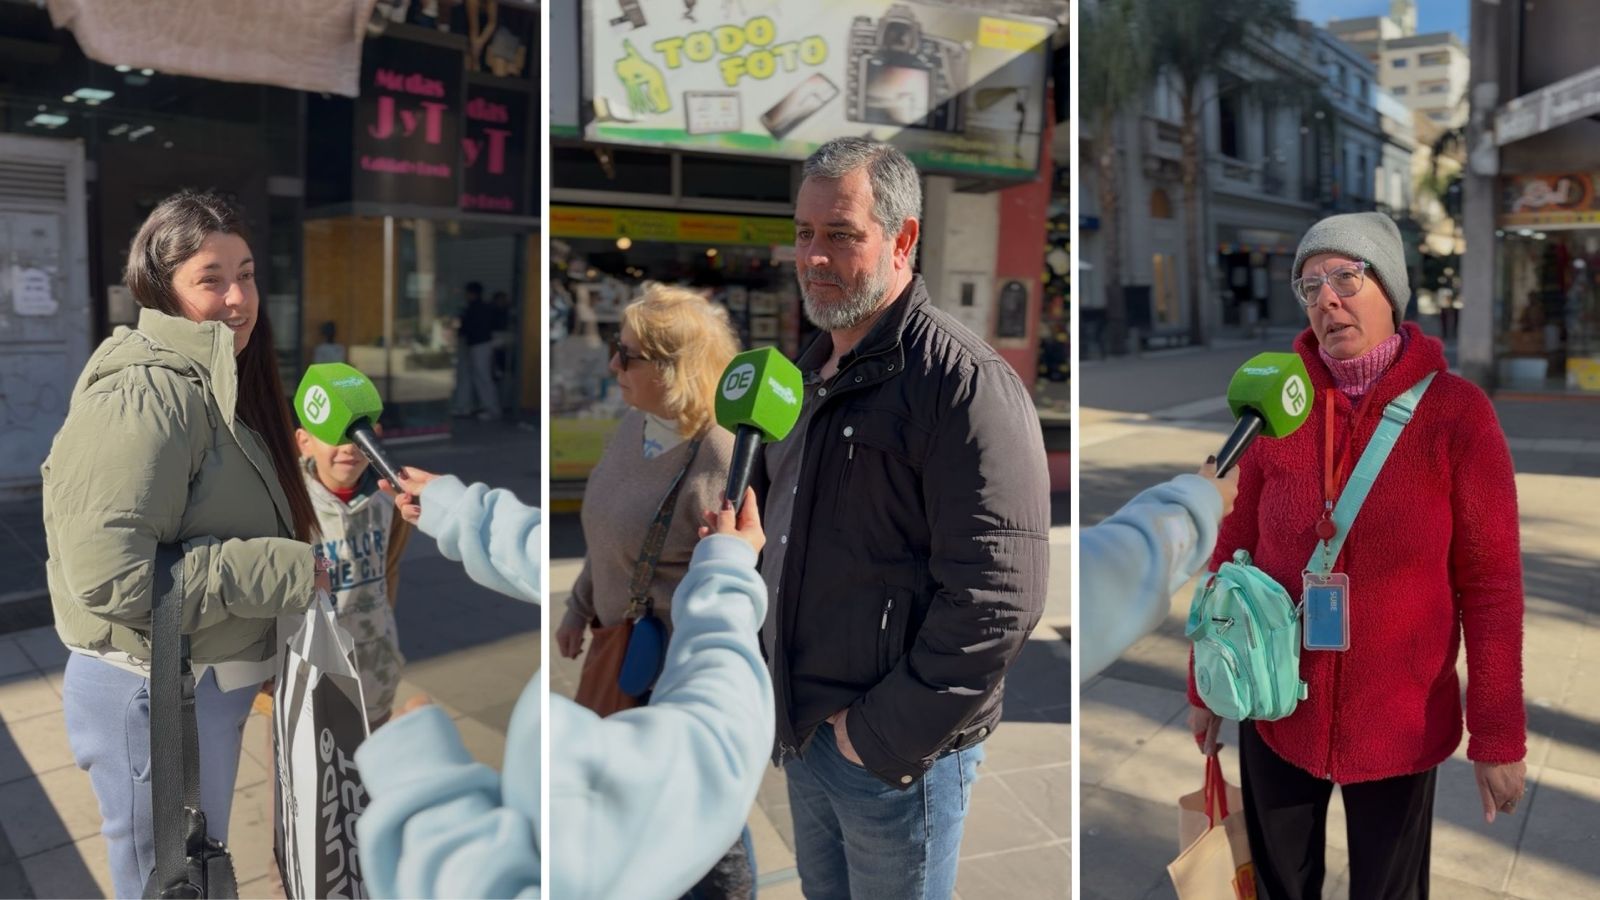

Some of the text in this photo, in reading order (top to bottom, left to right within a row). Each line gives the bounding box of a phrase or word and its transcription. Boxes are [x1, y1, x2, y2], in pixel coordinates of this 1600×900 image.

[652, 16, 776, 69] TODO
[719, 35, 828, 87] FOTO
[461, 128, 511, 175] yT
[725, 370, 752, 392] DE
[1286, 379, 1304, 413] DE
[306, 388, 327, 420] DE
[314, 530, 383, 560] EXLOR
[1329, 591, 1338, 612] SUBE
